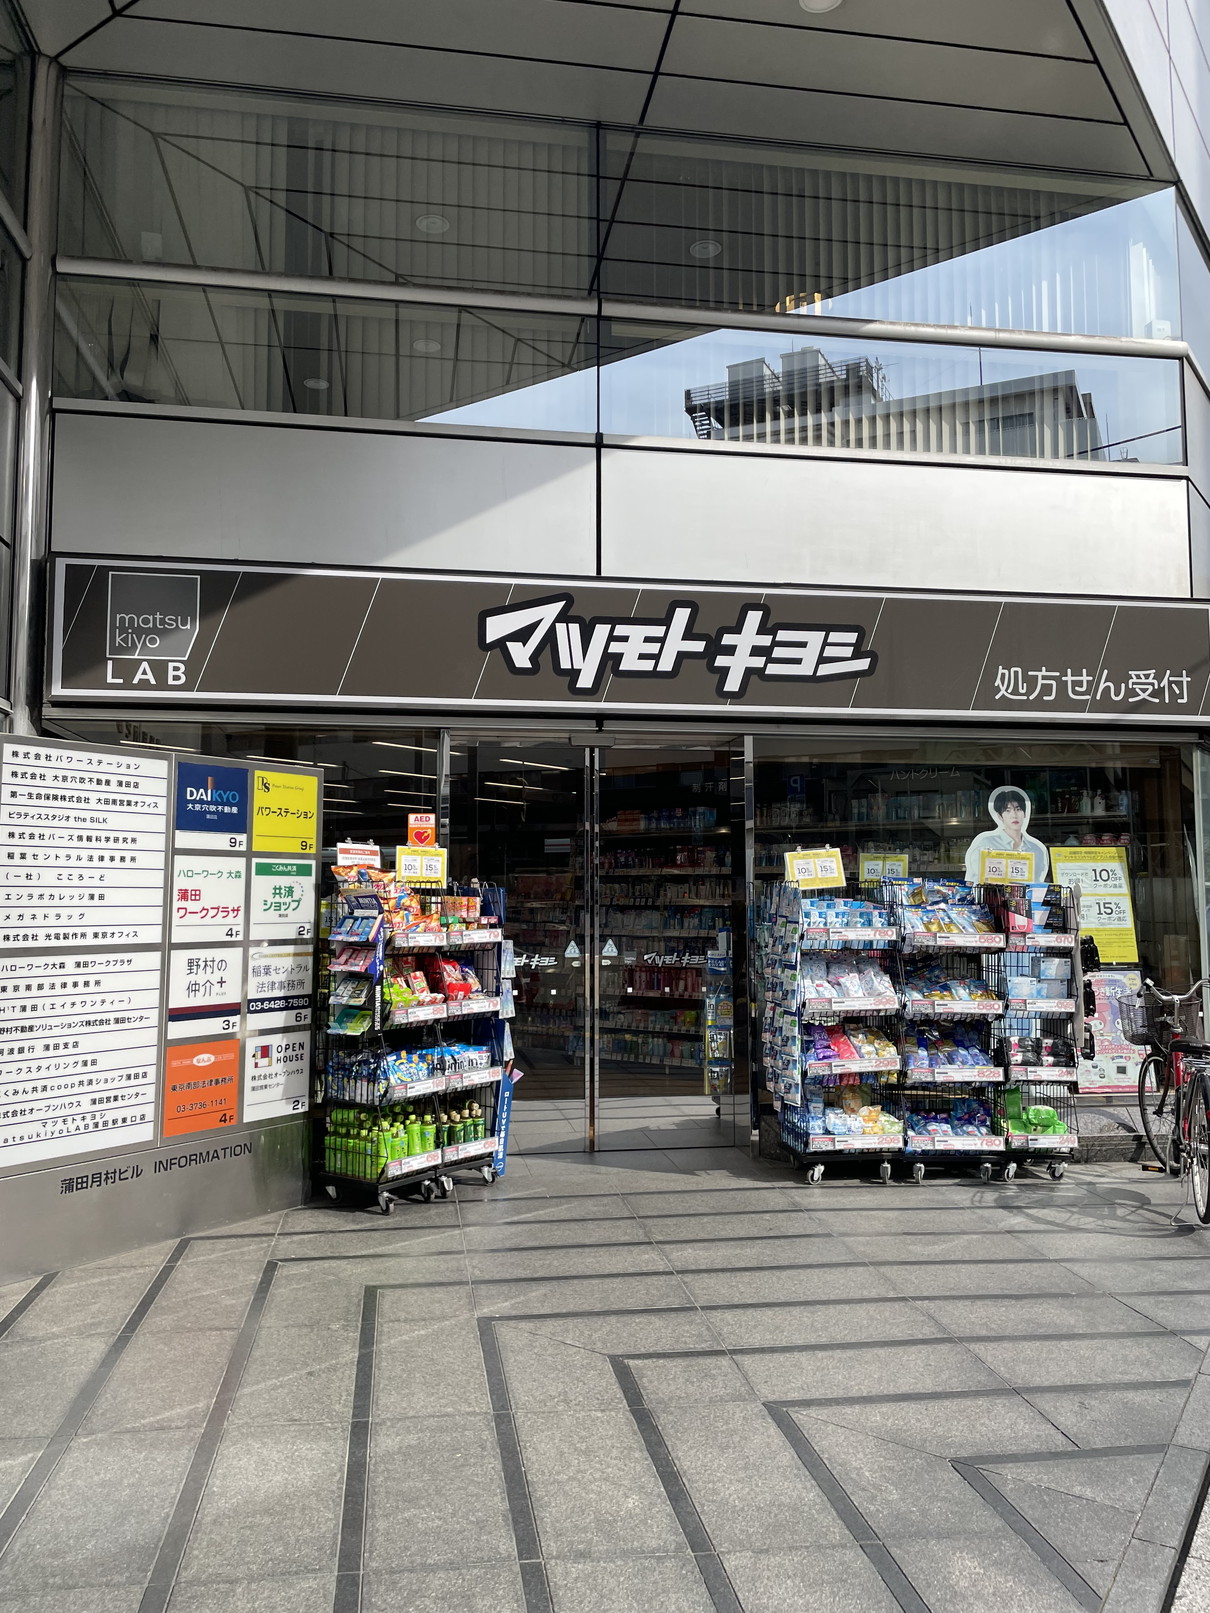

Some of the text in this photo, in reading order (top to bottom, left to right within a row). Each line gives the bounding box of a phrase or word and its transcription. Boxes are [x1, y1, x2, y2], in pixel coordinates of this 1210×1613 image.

[115, 611, 192, 631] matsu
[114, 628, 160, 656] kiyo
[485, 599, 872, 692] マツモトキヨシ
[105, 661, 187, 686] LAB
[994, 665, 1192, 704] 処方せん受付
[11, 750, 141, 770] 株式会社パワーステーション
[11, 770, 140, 789] 株式会社 大京穴吹不動産 蒲田店
[186, 777, 239, 802] DAIKYO
[10, 790, 90, 804] 第一生命保険株式会社
[186, 803, 239, 814] 大京穴吹不動産
[256, 806, 315, 820] パワーステーション
[89, 816, 108, 824] SILK
[7, 852, 137, 864] 稲葉セントラル法律事務所
[177, 869, 242, 879] ハローワーク 大森
[177, 888, 201, 902] 蒲田
[272, 885, 295, 899] 共済
[176, 905, 242, 919] ワークプラザ
[262, 899, 302, 912] ショップ
[4, 912, 86, 921] メガネドラッグ
[2, 930, 139, 942] 株式会社 光電製作所 東京オフィス
[978, 934, 1002, 944] 580
[1, 958, 133, 972] ハローワーク大森 蒲田ワークプラザ
[186, 957, 228, 976] 野村の
[643, 952, 707, 967] マツモトキヨシ
[251, 963, 310, 978] 稲葉セントラル
[0, 979, 102, 993] 東京南部法律事務所
[256, 979, 306, 993] 法律事務所
[249, 998, 309, 1011] 03-6428-7590
[977, 1003, 1000, 1011] 580
[113, 1015, 150, 1024] 蒲田センター
[43, 1041, 80, 1052] 蒲田支店
[276, 1041, 305, 1054] OPEN
[276, 1053, 305, 1064] HOUSE
[251, 1068, 304, 1082] 株式会社オープンハウス
[0, 1072, 148, 1097] くみん共済coop共済ショップ蒲田店
[170, 1076, 234, 1093] 東京南部法律事務所
[0, 1092, 147, 1119] 式会社オープンハウス 蒲田営業センター
[176, 1098, 227, 1113] 03-3736-1141
[41, 1112, 107, 1128] マツモトキヨシ
[59, 1141, 253, 1195] 蒲田月村ビル INFORMATION
